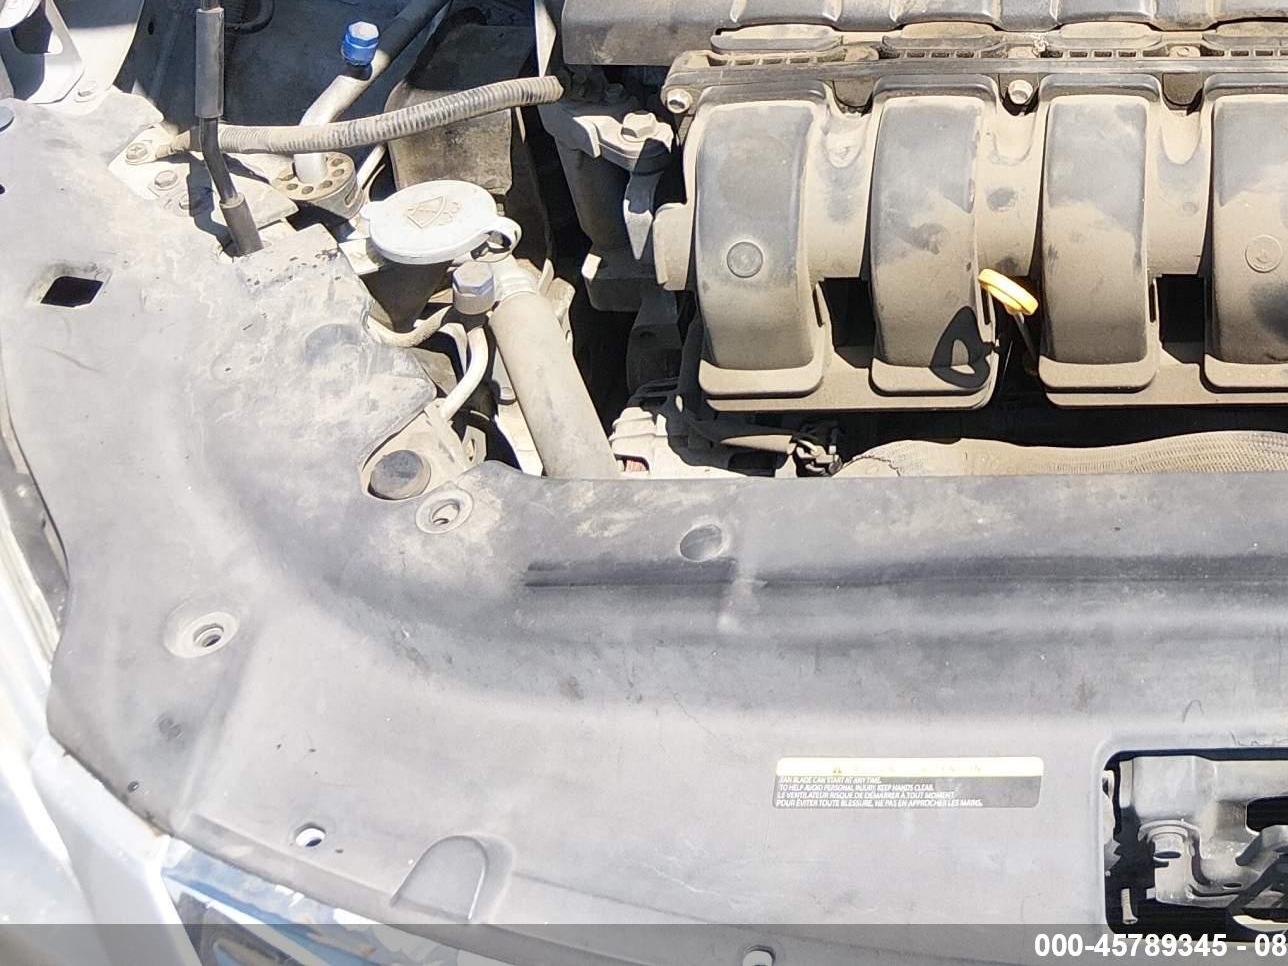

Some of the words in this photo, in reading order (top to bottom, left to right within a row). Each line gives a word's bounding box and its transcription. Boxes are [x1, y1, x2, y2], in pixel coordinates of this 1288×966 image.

[786, 791, 829, 799] VENTILATEUR
[829, 791, 854, 799] RISQUE
[908, 791, 924, 799] TOUT
[776, 799, 795, 807] POUR
[819, 799, 839, 807] TOUTE
[875, 799, 884, 807] NE
[885, 799, 897, 807] PAS
[898, 799, 907, 807] EN
[907, 799, 947, 807] APPROCHER
[947, 799, 960, 807] LES
